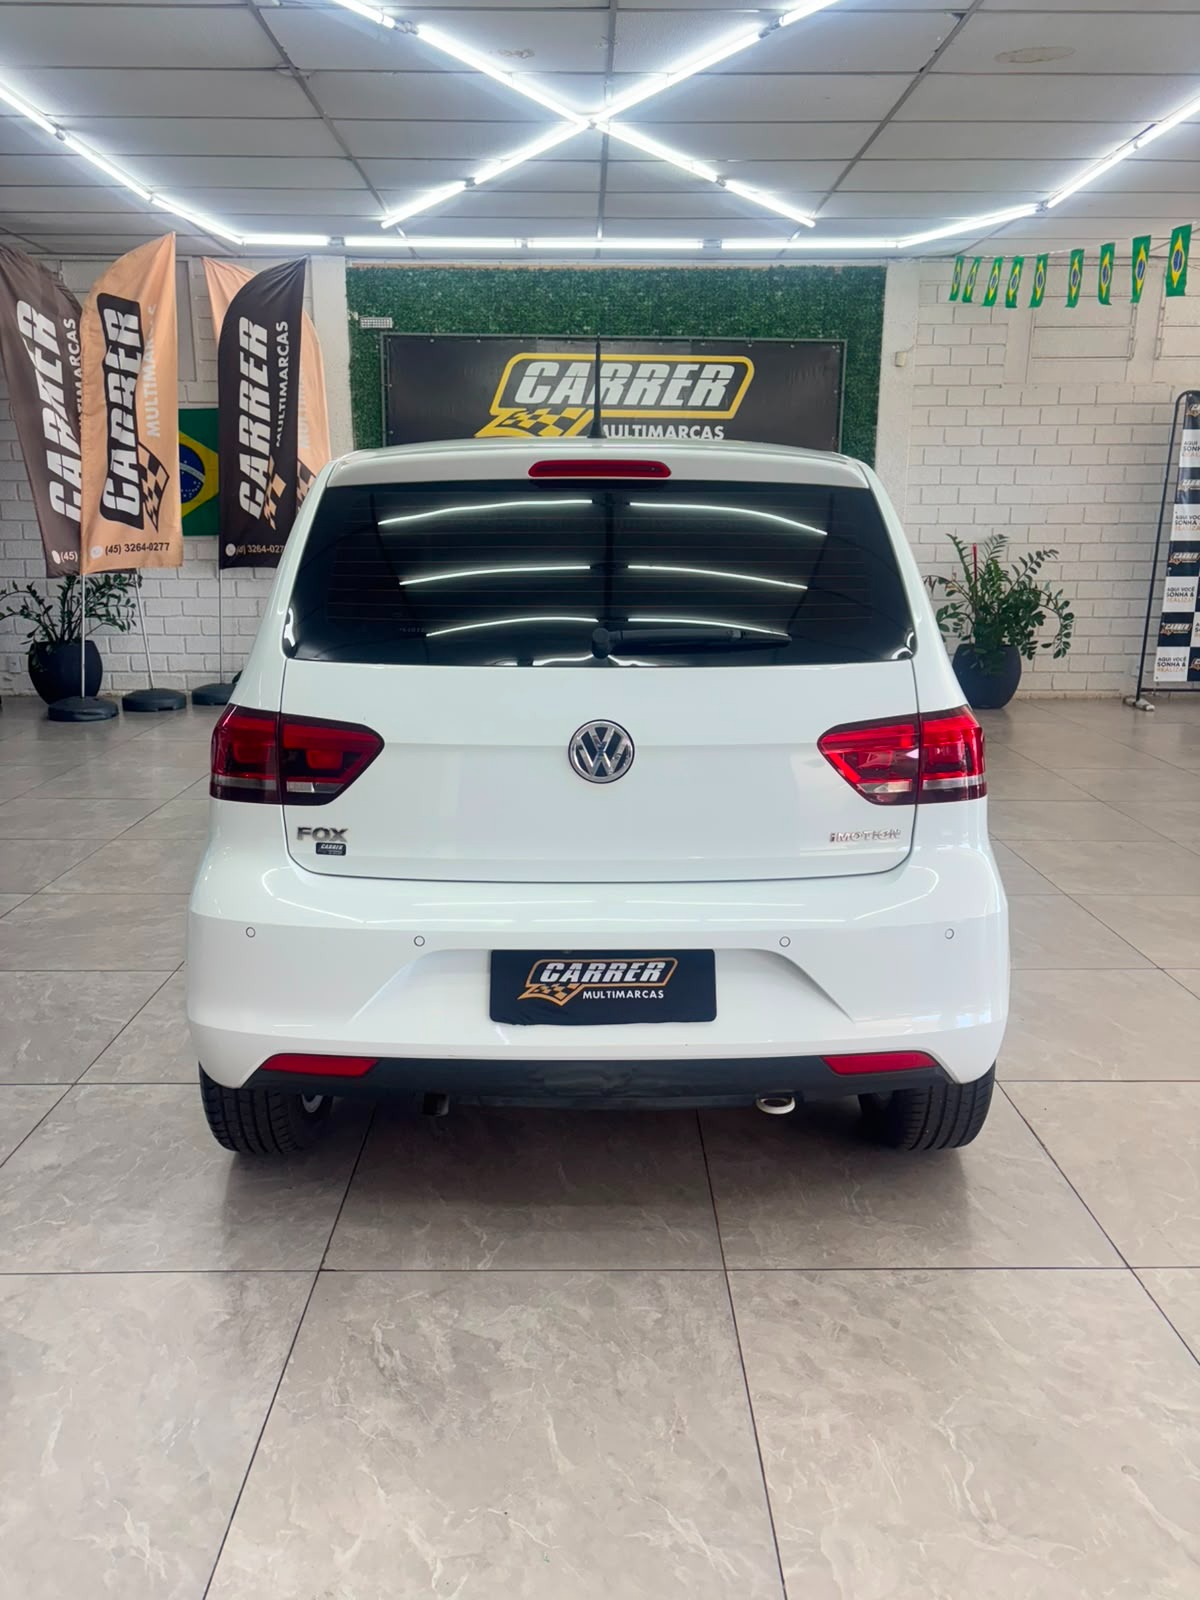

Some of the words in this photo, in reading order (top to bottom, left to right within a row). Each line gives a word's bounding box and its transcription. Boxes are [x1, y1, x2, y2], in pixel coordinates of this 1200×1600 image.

[514, 361, 736, 407] CARRER
[239, 316, 272, 520] CARRER
[105, 544, 121, 556] (45)
[124, 542, 170, 552] 3264-0277
[297, 826, 348, 842] FOX
[540, 962, 666, 983] CARRER
[582, 989, 664, 1000] MULTIMARCAS
